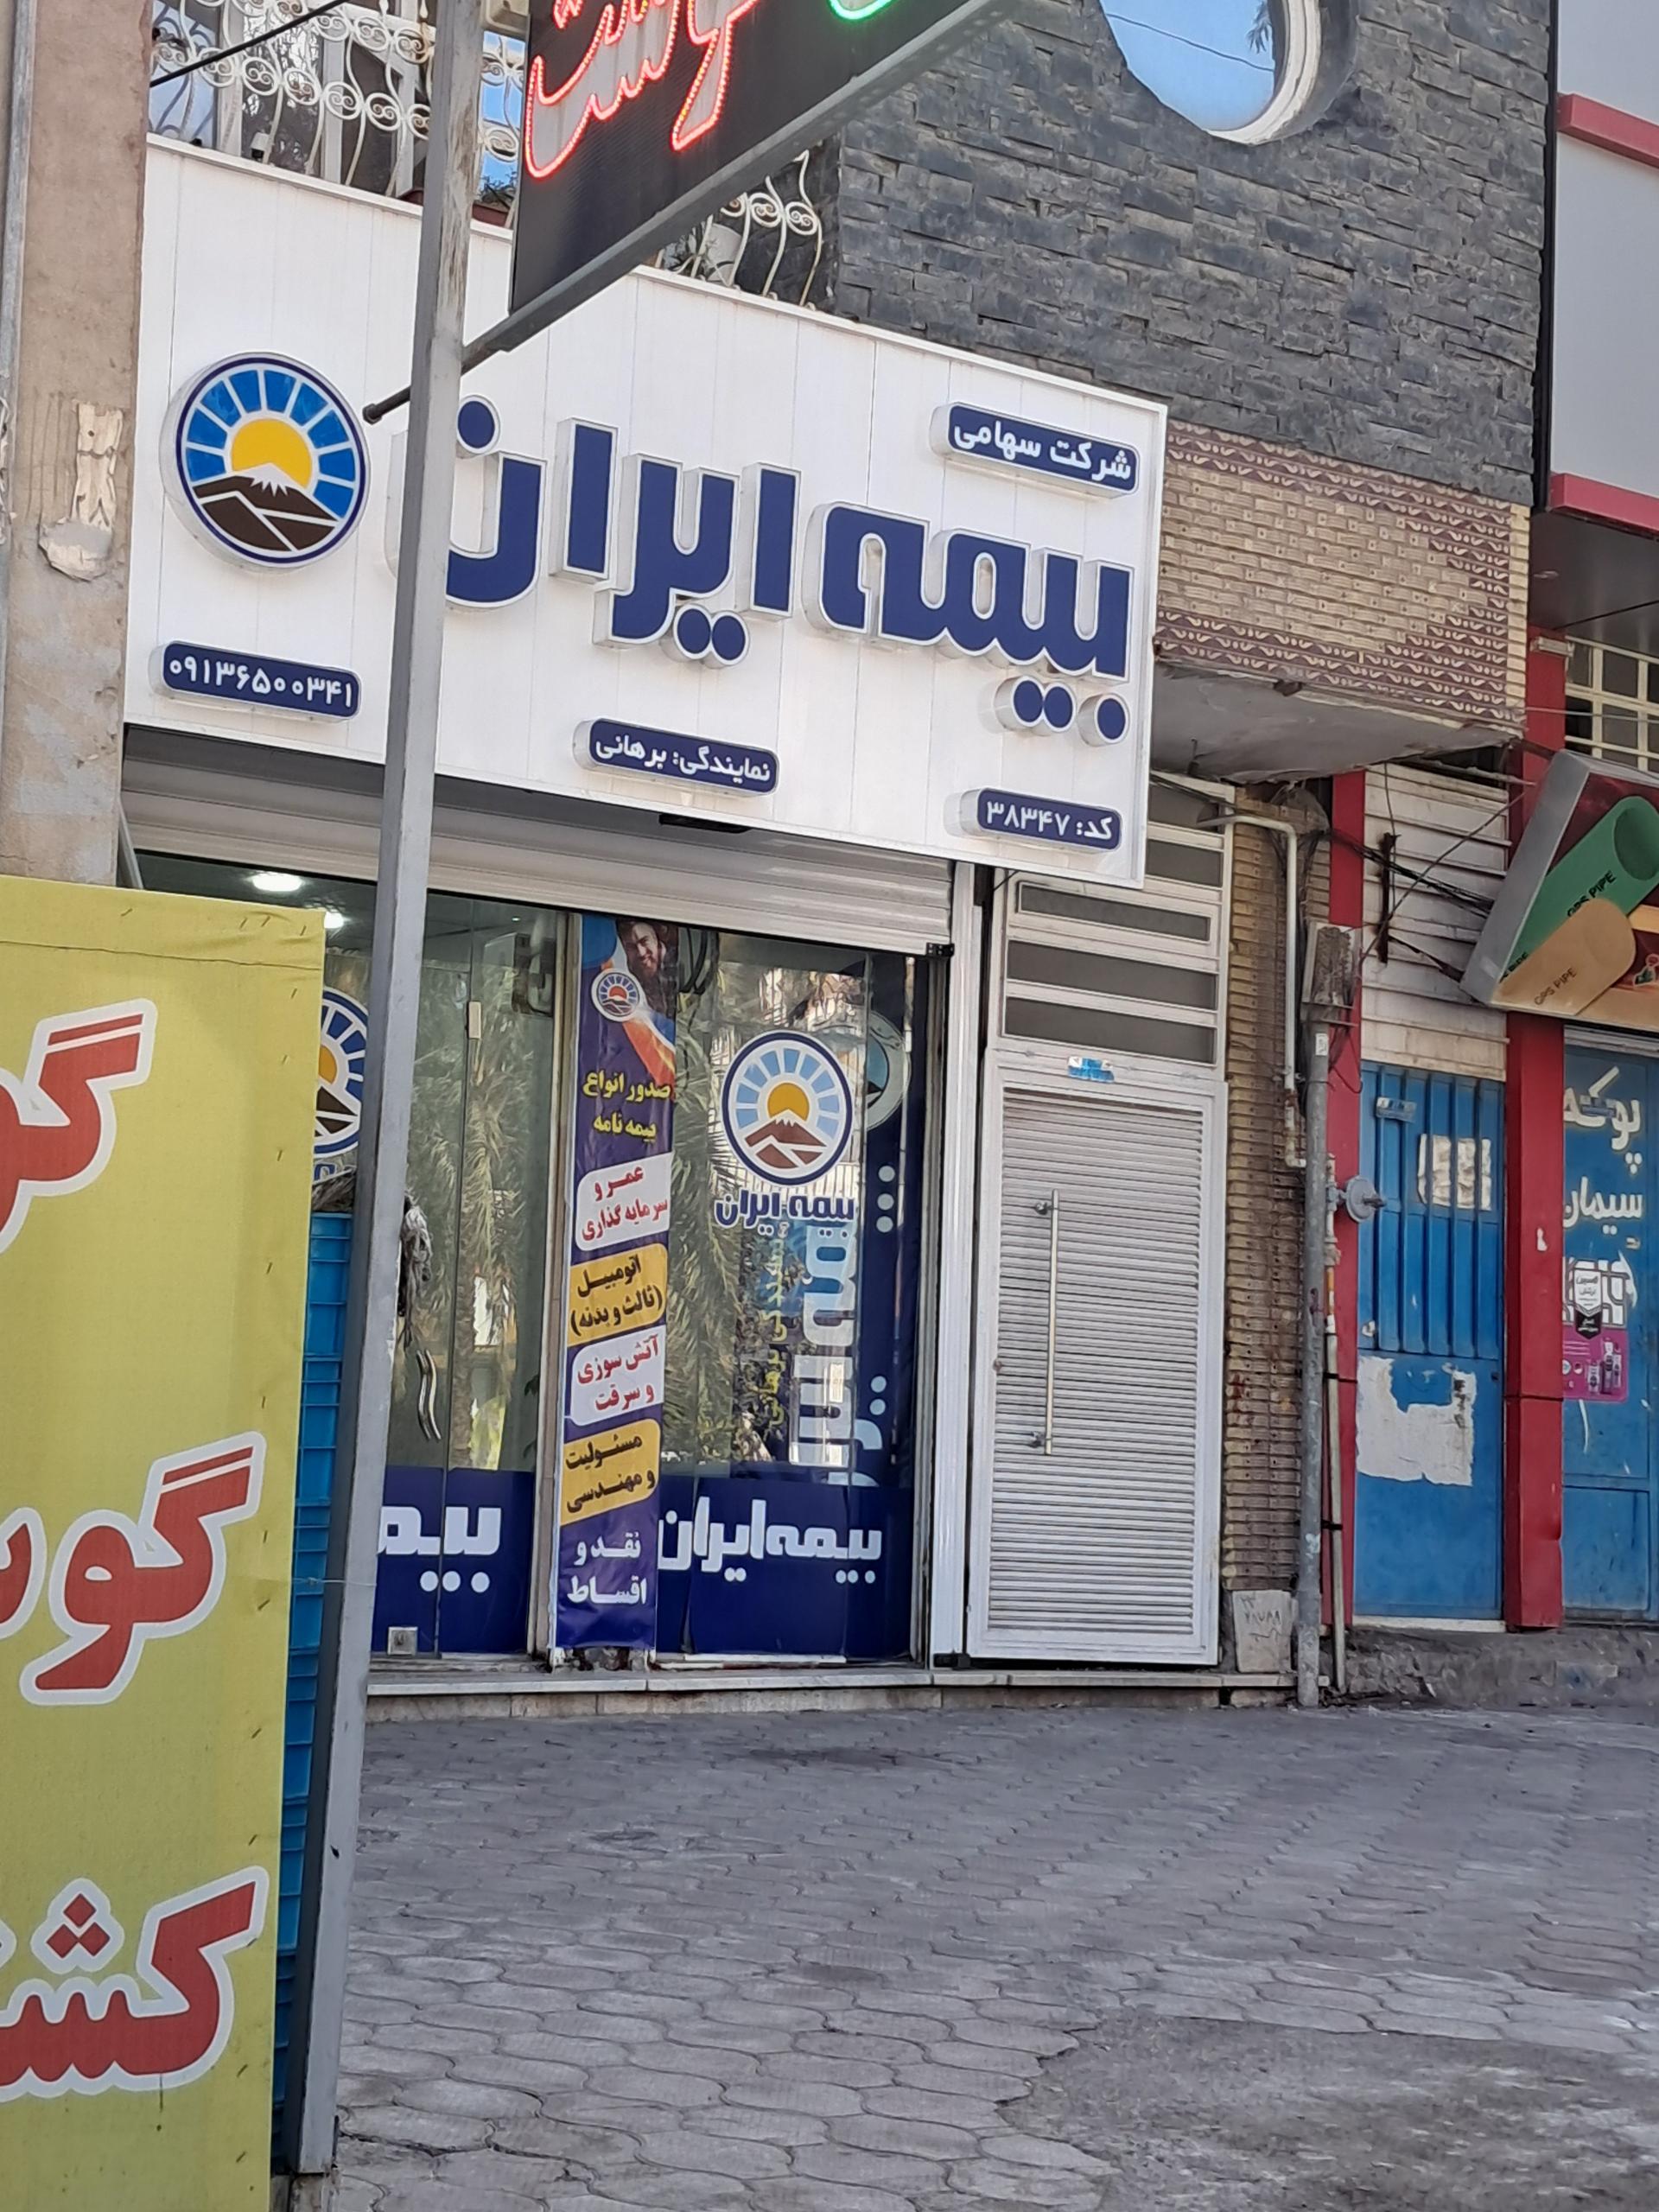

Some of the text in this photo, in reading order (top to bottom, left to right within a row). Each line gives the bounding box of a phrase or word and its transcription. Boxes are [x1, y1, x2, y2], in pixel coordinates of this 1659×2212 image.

[954, 420, 1131, 482] شرکت سهامی
[818, 501, 1135, 743] بیمه
[169, 655, 352, 709] ۰۹۱۳۶۵۰۰۳۴۱
[595, 734, 771, 784] نمایندگی: برهانی
[987, 800, 1113, 840] کد: ۳۸۳۴۷
[1588, 869, 1617, 899] PIPE
[582, 1070, 671, 1103] صدور انواع
[594, 1111, 657, 1142] بیمه نامه
[594, 1166, 644, 1202] عمر و
[625, 1198, 668, 1225] سرمایه
[714, 1188, 855, 1239] بیمه ایران
[1563, 1176, 1643, 1235] سیمان
[577, 1253, 642, 1298] اتومبیل
[613, 1306, 621, 1326] و
[622, 1284, 663, 1315] (ثالث
[577, 1333, 658, 1384] آتش سوزی
[594, 1383, 655, 1411] و سرقت
[565, 1433, 643, 1471] مسئولیت
[566, 1469, 656, 1514] و مهندسی
[377, 1505, 502, 1594] بیم
[573, 1530, 641, 1566] نقد و
[657, 1495, 883, 1584] بیمه ایران
[566, 1574, 647, 1605] اقساط
[0, 1879, 257, 2089] کش
